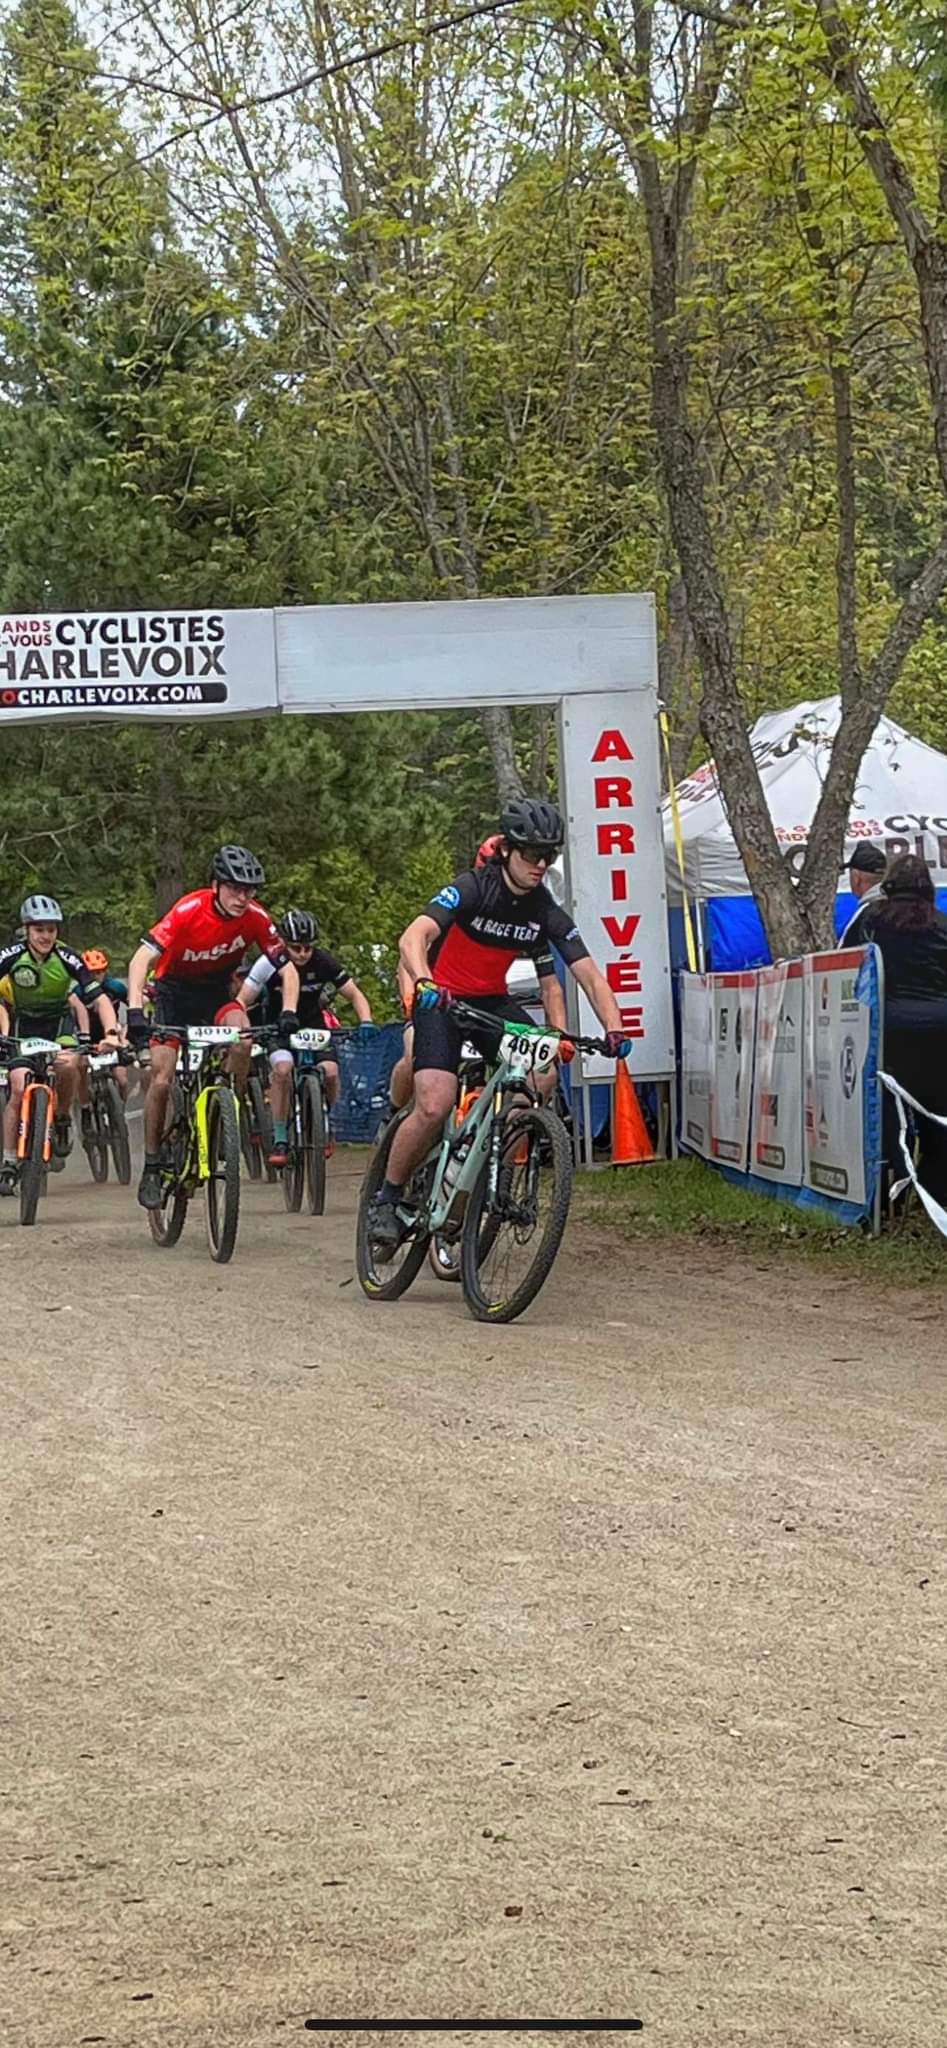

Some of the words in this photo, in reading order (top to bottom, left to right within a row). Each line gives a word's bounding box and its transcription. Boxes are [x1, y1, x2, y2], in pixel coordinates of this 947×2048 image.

[2, 620, 51, 633] ANDS
[56, 616, 225, 646] CYCLISTES
[0, 634, 52, 647] -VOUS
[183, 935, 246, 961] MSA
[508, 1036, 550, 1061] 4016
